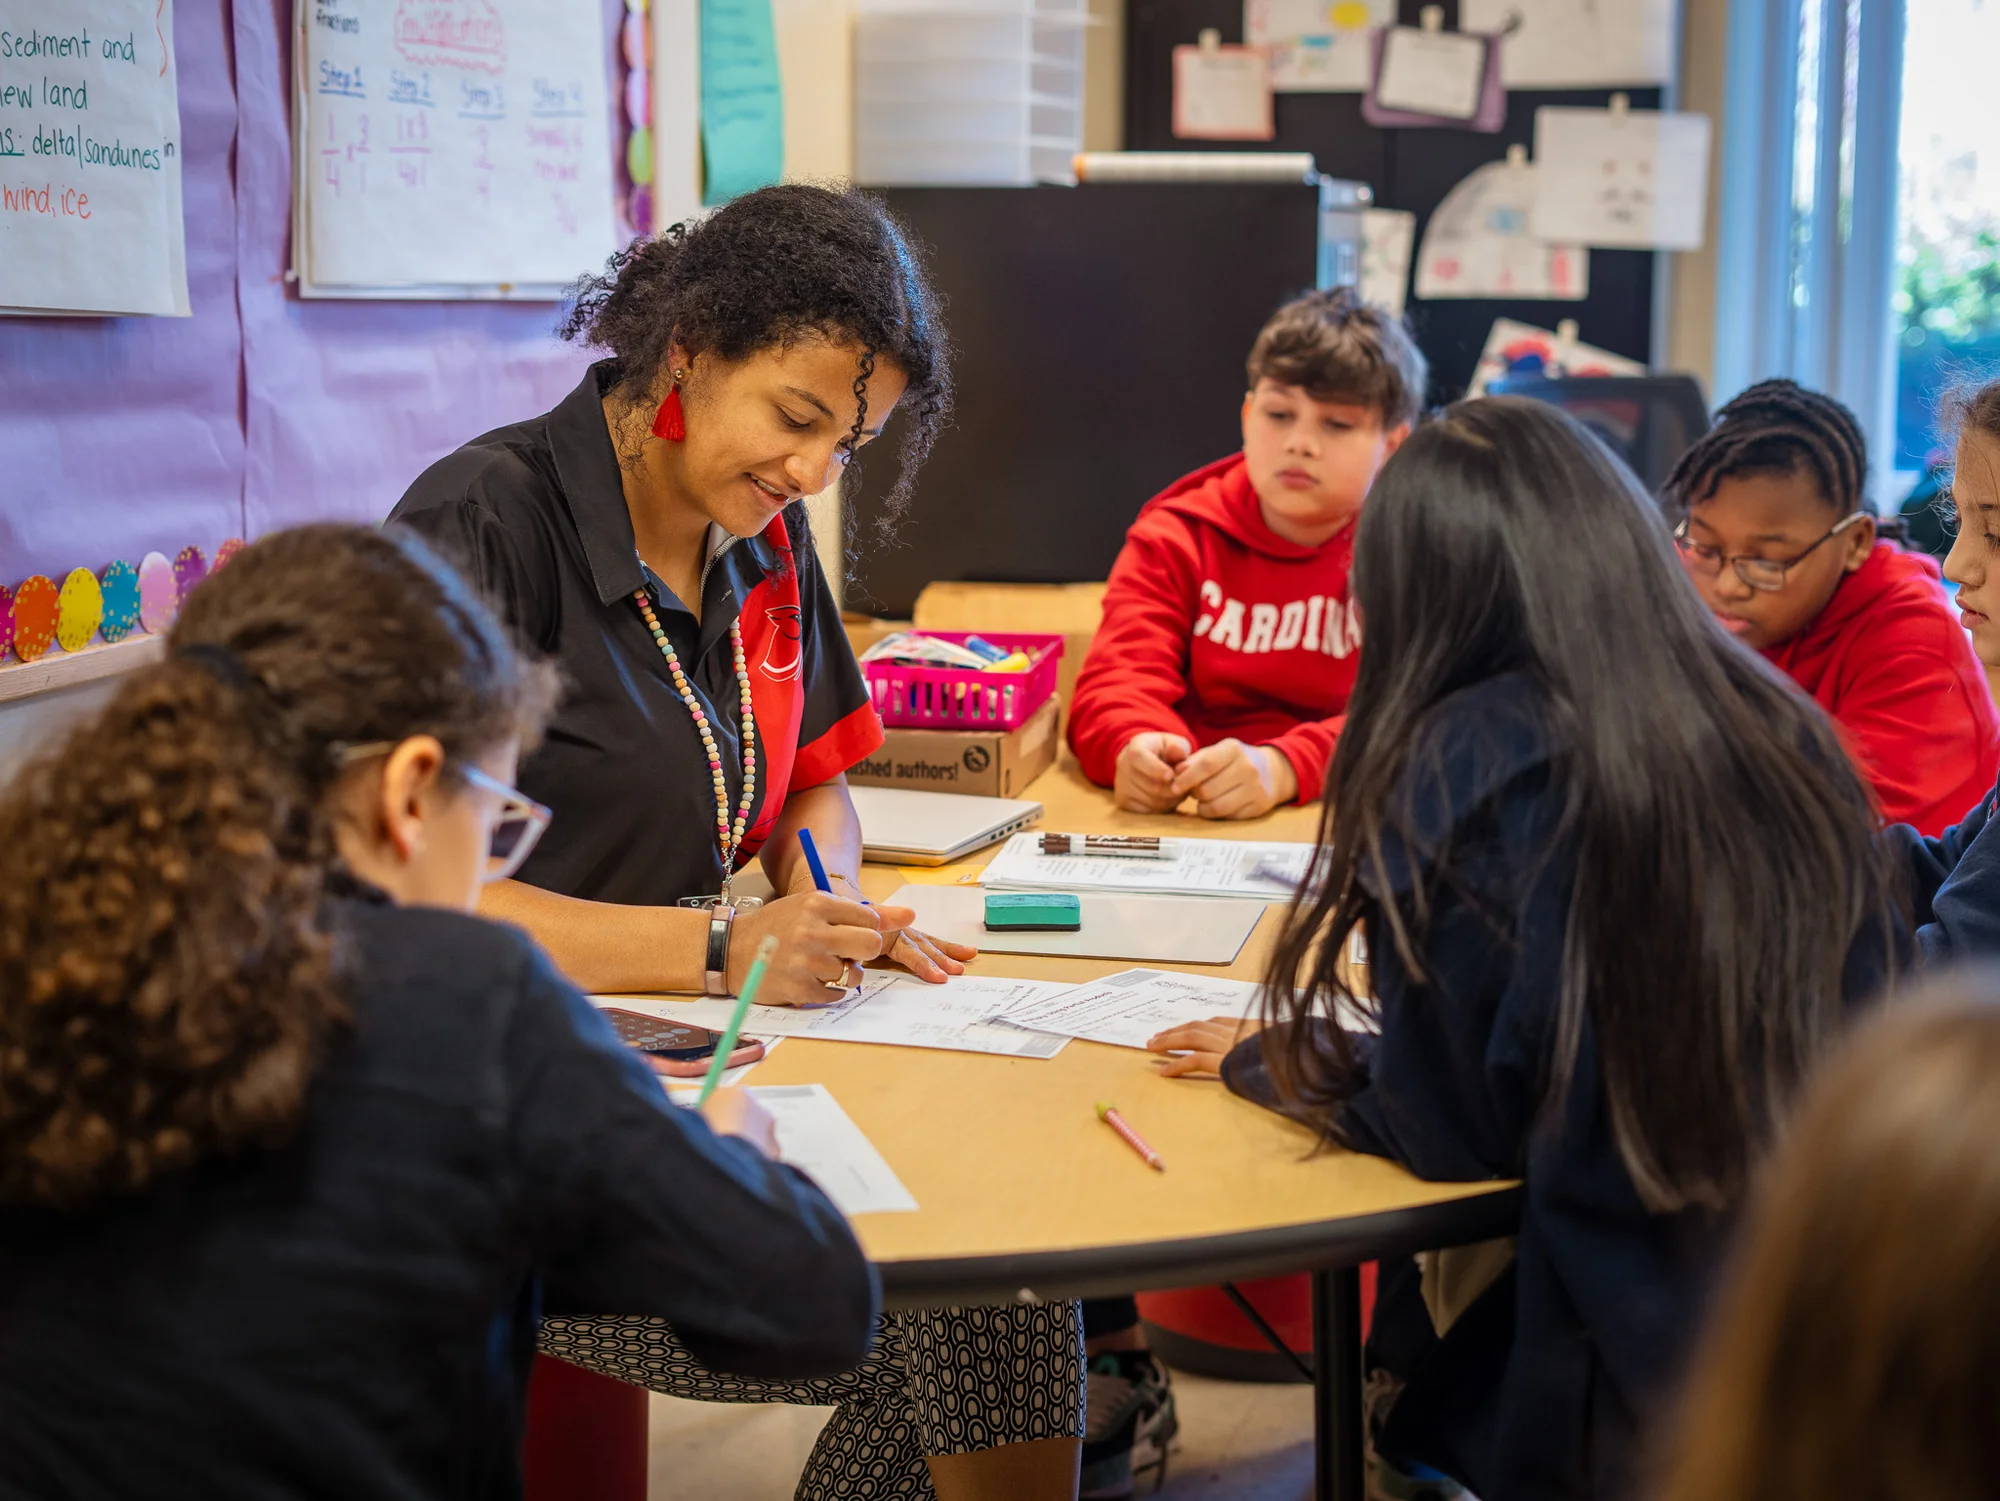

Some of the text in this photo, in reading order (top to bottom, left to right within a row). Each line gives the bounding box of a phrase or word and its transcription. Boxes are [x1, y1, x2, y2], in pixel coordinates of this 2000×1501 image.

[102, 32, 135, 65] and
[43, 76, 88, 110] land
[61, 184, 92, 219] ice
[895, 760, 959, 782] authors!
